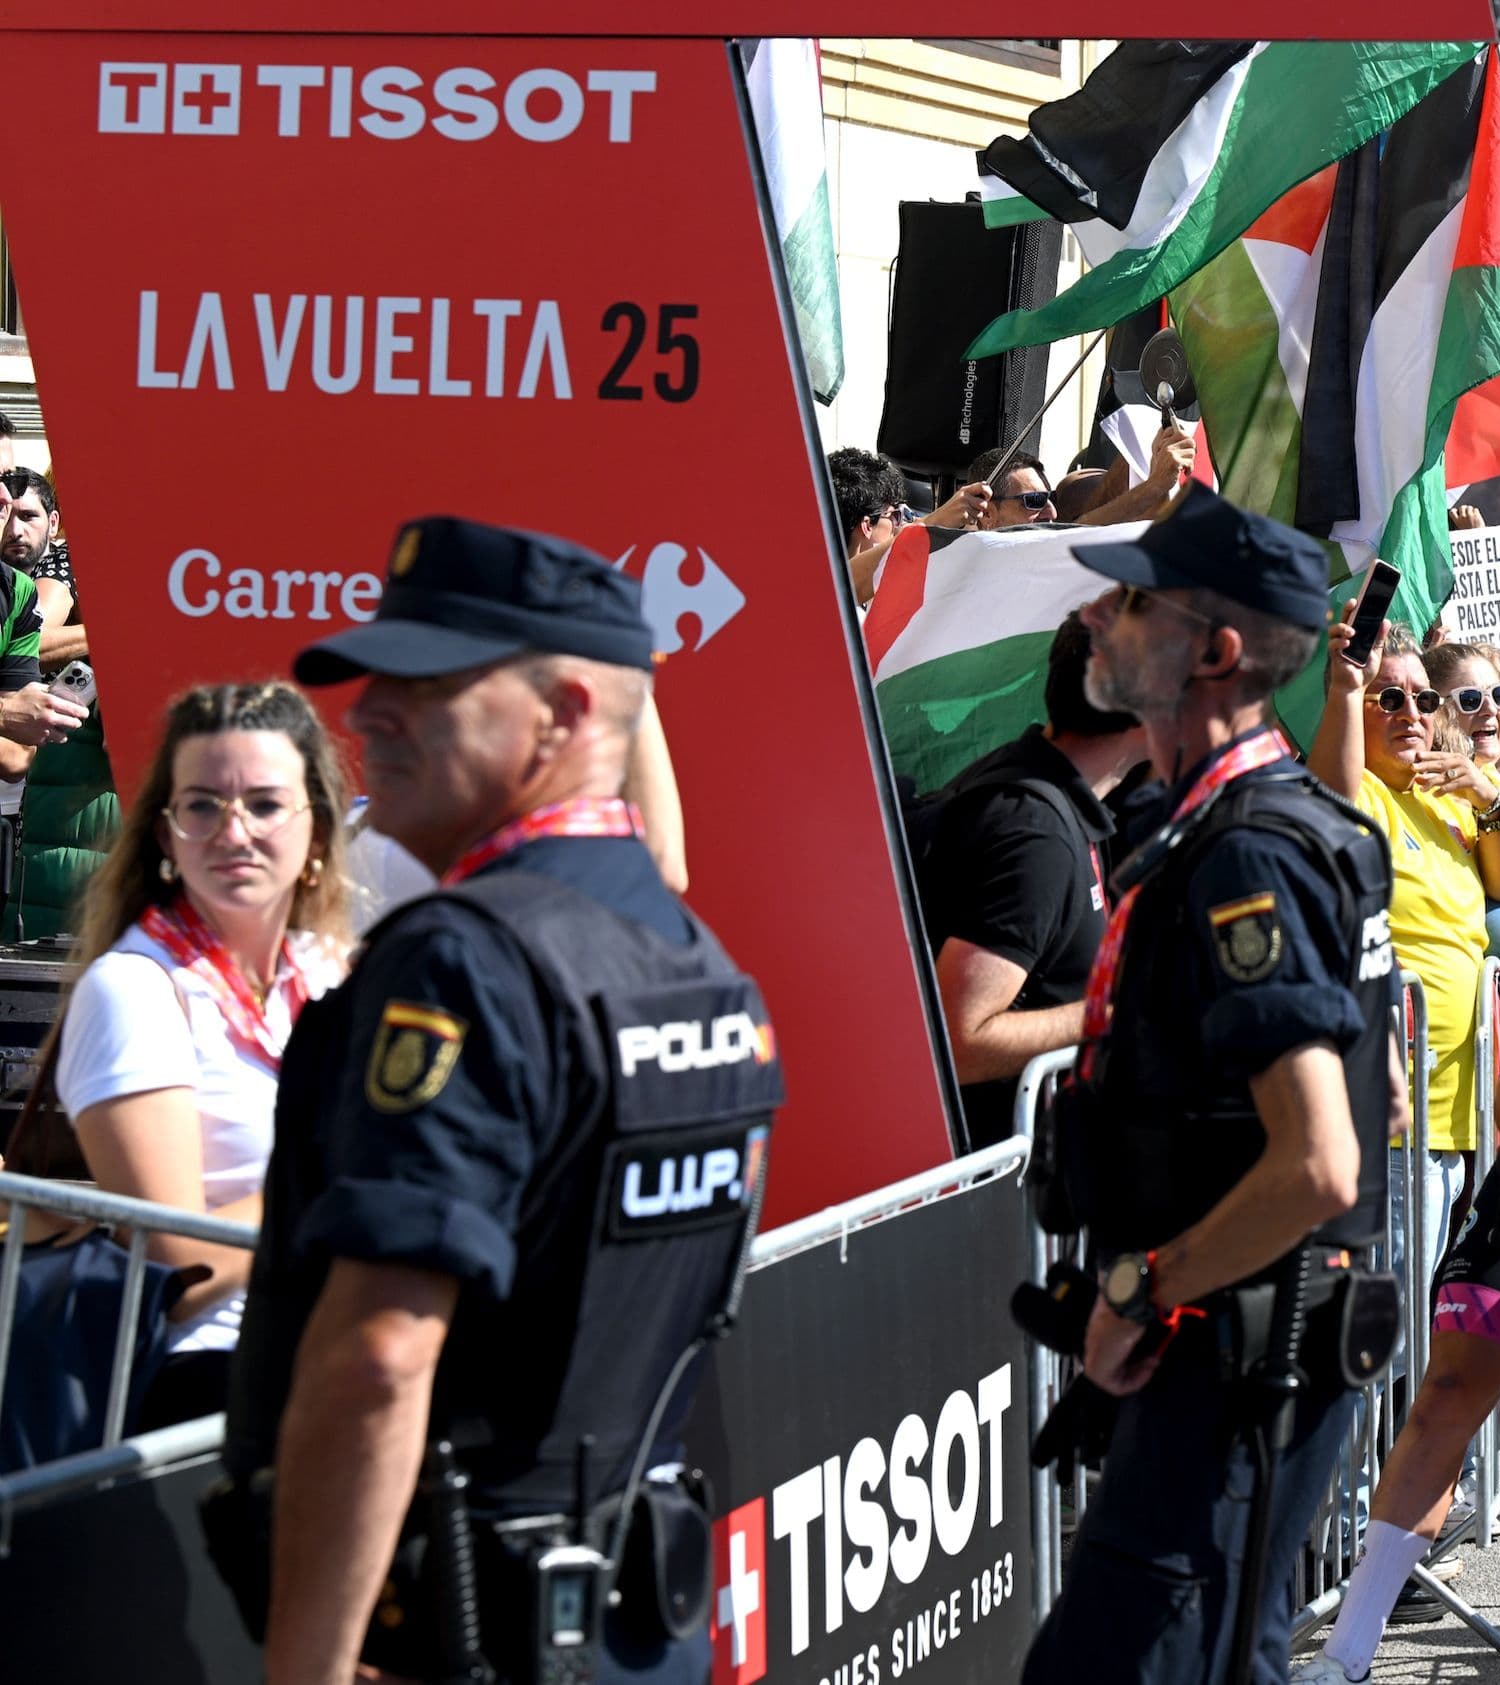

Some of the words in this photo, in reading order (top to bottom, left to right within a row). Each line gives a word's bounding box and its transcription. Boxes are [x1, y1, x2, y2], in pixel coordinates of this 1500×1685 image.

[257, 65, 657, 143] TISSOT
[137, 290, 234, 390] LA
[253, 294, 573, 400] VUELTA
[597, 301, 701, 404] 25
[959, 360, 977, 445] dBTechnologies
[167, 548, 384, 623] Carre
[1451, 539, 1482, 568] ESDE
[1485, 537, 1500, 563] EL
[1452, 571, 1484, 601] ASTA
[772, 1362, 1012, 1657] TISSOT
[891, 1589, 961, 1678] SINCE
[970, 1551, 1014, 1623] 1853
